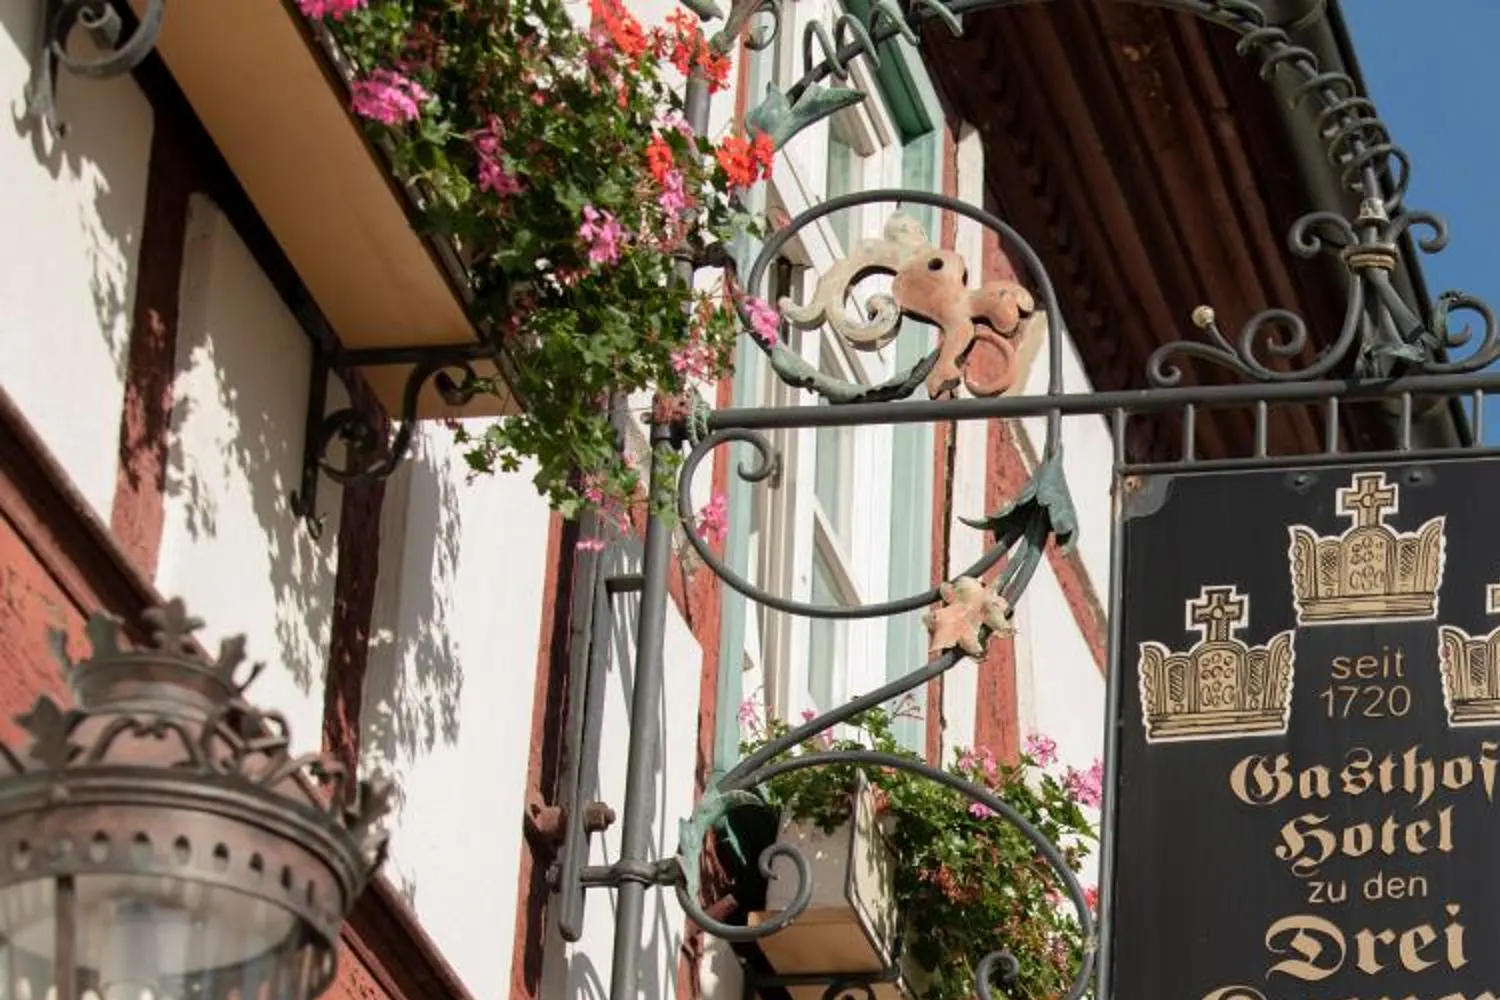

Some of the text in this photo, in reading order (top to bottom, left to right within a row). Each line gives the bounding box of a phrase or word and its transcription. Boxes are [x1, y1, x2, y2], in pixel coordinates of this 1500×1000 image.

[1330, 645, 1405, 680] seit
[1318, 684, 1411, 719] 1720
[1229, 741, 1500, 806] Gasthof
[1274, 805, 1454, 878] Hotel
[1307, 870, 1428, 904] zu den
[1264, 903, 1469, 982] Drei
